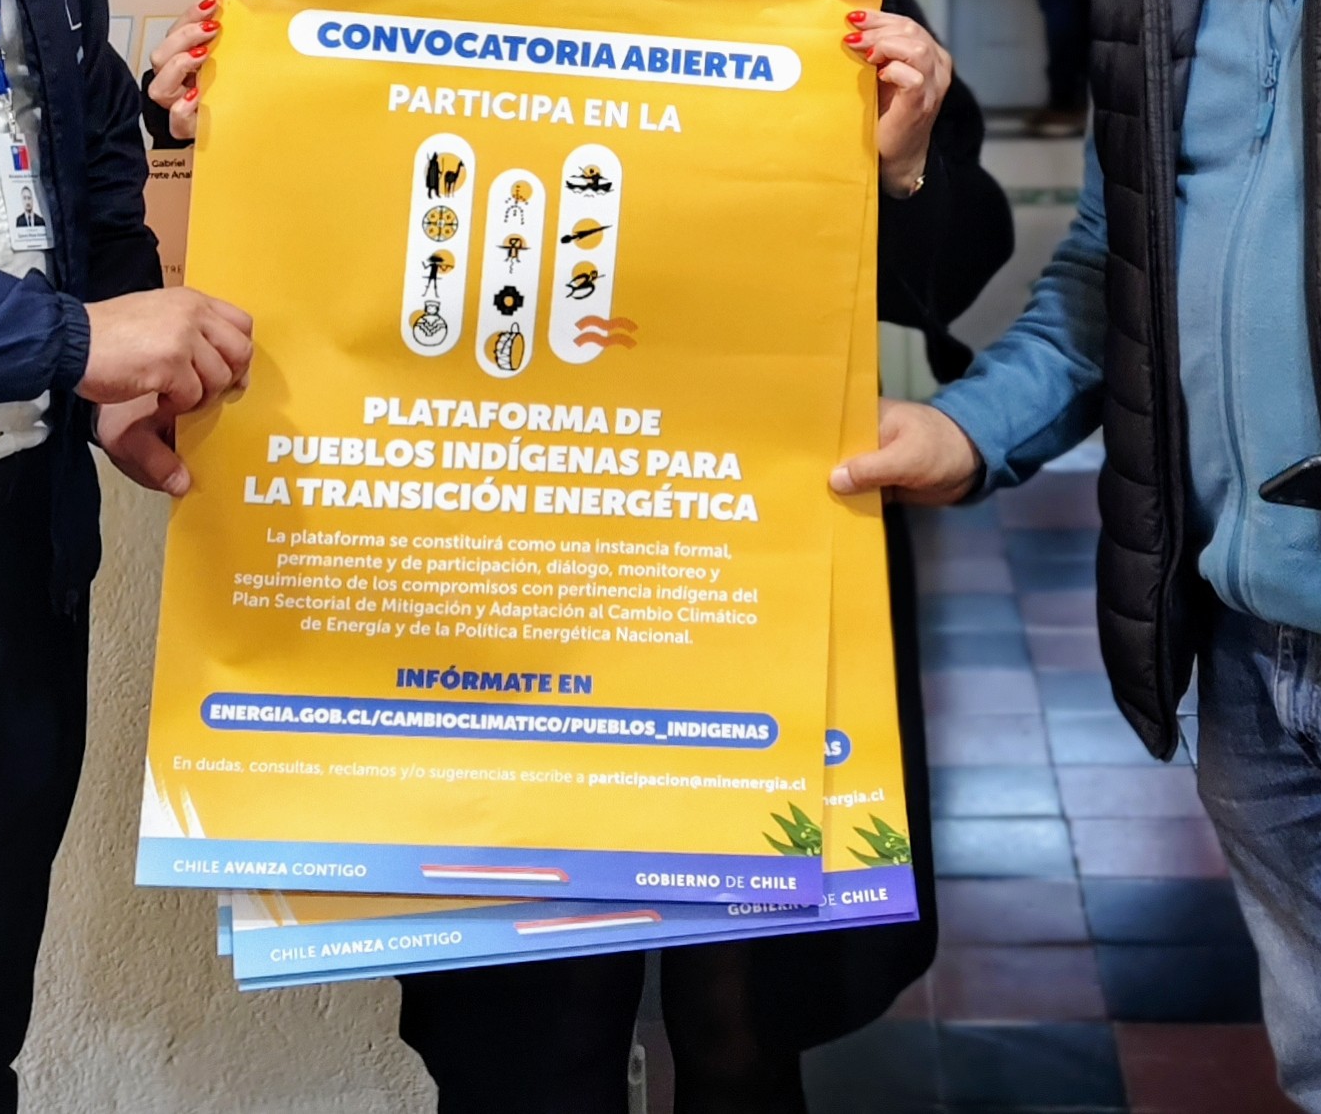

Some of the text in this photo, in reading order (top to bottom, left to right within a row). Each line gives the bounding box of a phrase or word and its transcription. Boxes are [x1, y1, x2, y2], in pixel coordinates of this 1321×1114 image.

[316, 21, 774, 82] CONVOCATORIA ABIERTA
[388, 83, 682, 133] PARTICIPA EN LA
[151, 158, 186, 168] Gabriel
[363, 396, 661, 436] PLATAFORMA DE
[267, 434, 742, 480] PUEBLOS INDÍGENAS PARA
[243, 475, 759, 522] LA TRANSICIÓN ENERGÉTICA
[267, 527, 732, 560] La plataforma se constituirá como una instancia formal,
[276, 552, 720, 583] permanente y de participación, diálogo, monitoreo y
[233, 572, 758, 605] seguimiento de los compromisos con pertinencia indígena del
[232, 590, 758, 625] Plan Sectorial de Mitigación y Adaptación al Cambio Climático
[300, 616, 694, 645] de Energía y de la Política Energética Nacional.
[396, 666, 592, 695] INFÓRMATE EN
[209, 704, 770, 741] ENERGIA.GOB.CL/CAMBIOCLIMATICO/PUEBLOS_INDIGENAS
[173, 755, 807, 793] En dudas, consultas, reclamos y/o sugerencias escribe a participacion@minenergia.cl
[173, 860, 368, 878] CHILE AVANZA CONTIGO
[636, 873, 797, 890] GOBIERNO DE CHILE
[841, 888, 889, 904] CHILE
[270, 931, 463, 962] CHILE AVANZA CONTIGO
